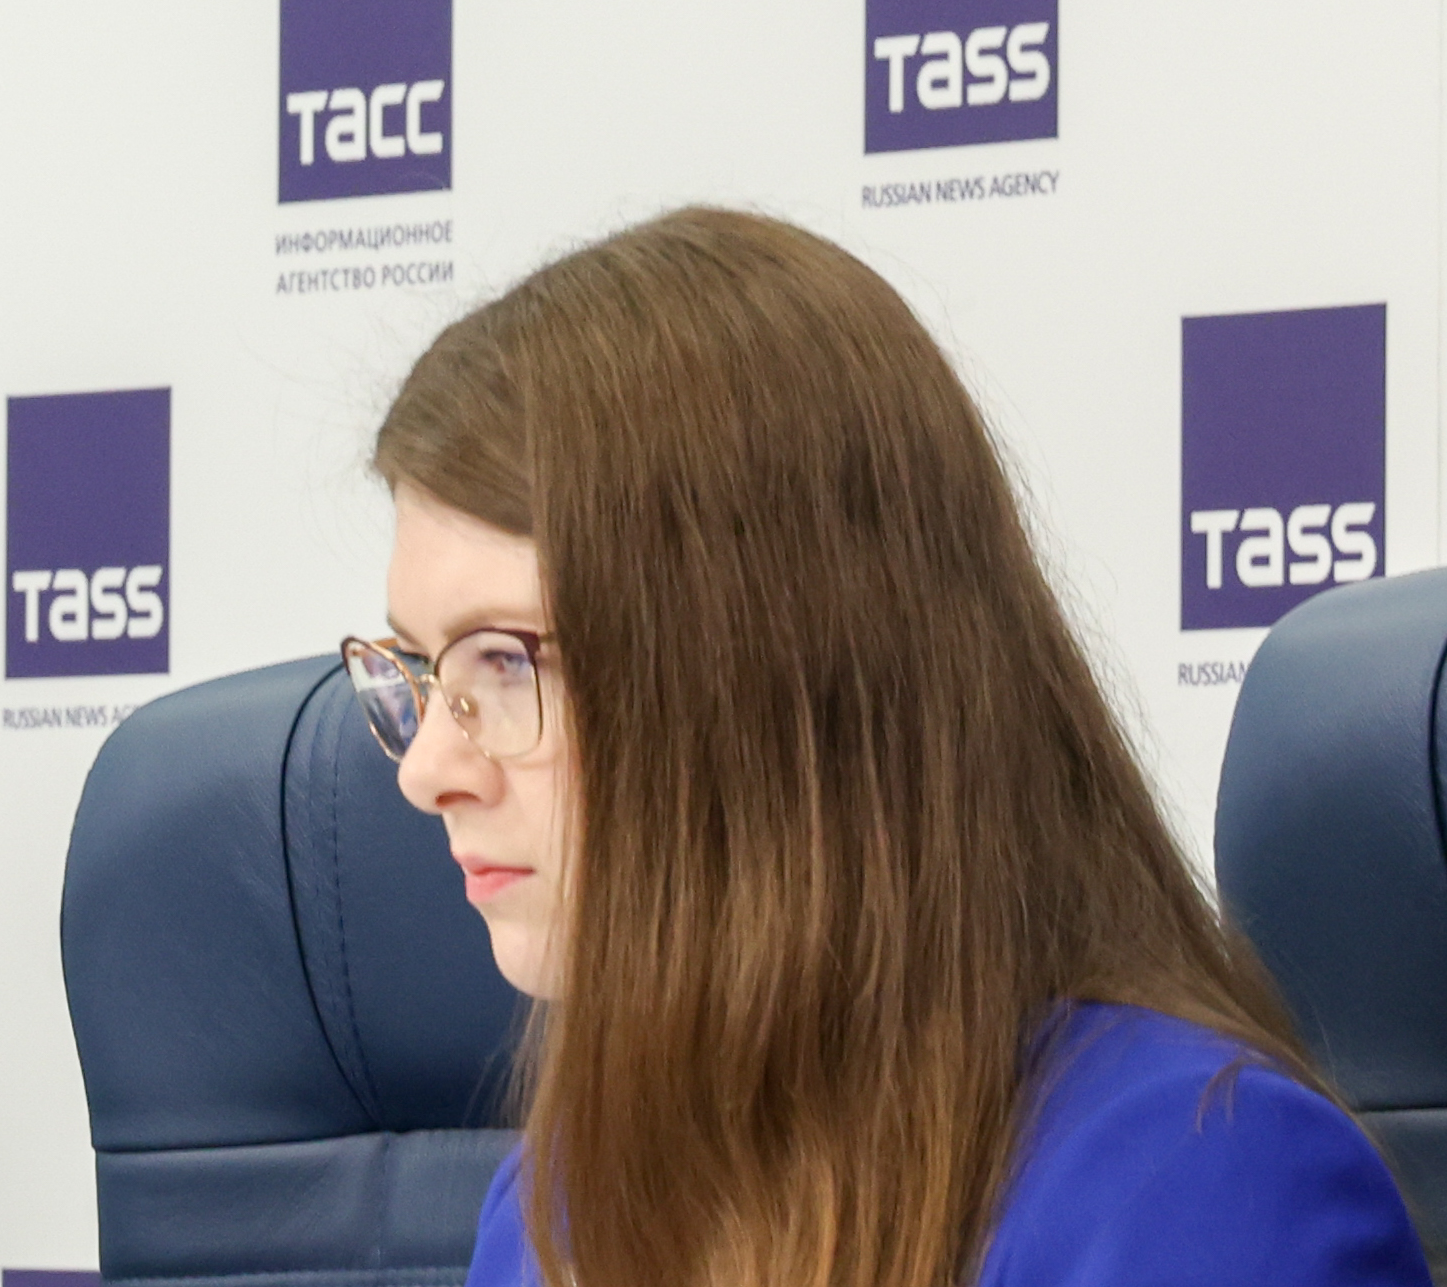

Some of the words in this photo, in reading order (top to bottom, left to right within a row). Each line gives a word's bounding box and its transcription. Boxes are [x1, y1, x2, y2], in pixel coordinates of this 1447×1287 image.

[861, 183, 931, 210] RUSSIAN
[935, 177, 986, 203] NEWS
[989, 171, 1061, 199] AGENCY
[275, 220, 454, 257] ИНФОРМАЦИОННОЕ
[276, 266, 377, 295] АГЕНТСТВО
[382, 261, 455, 288] РОССИИ
[2, 705, 62, 730] RUSSIAN
[65, 704, 107, 728] NEWS
